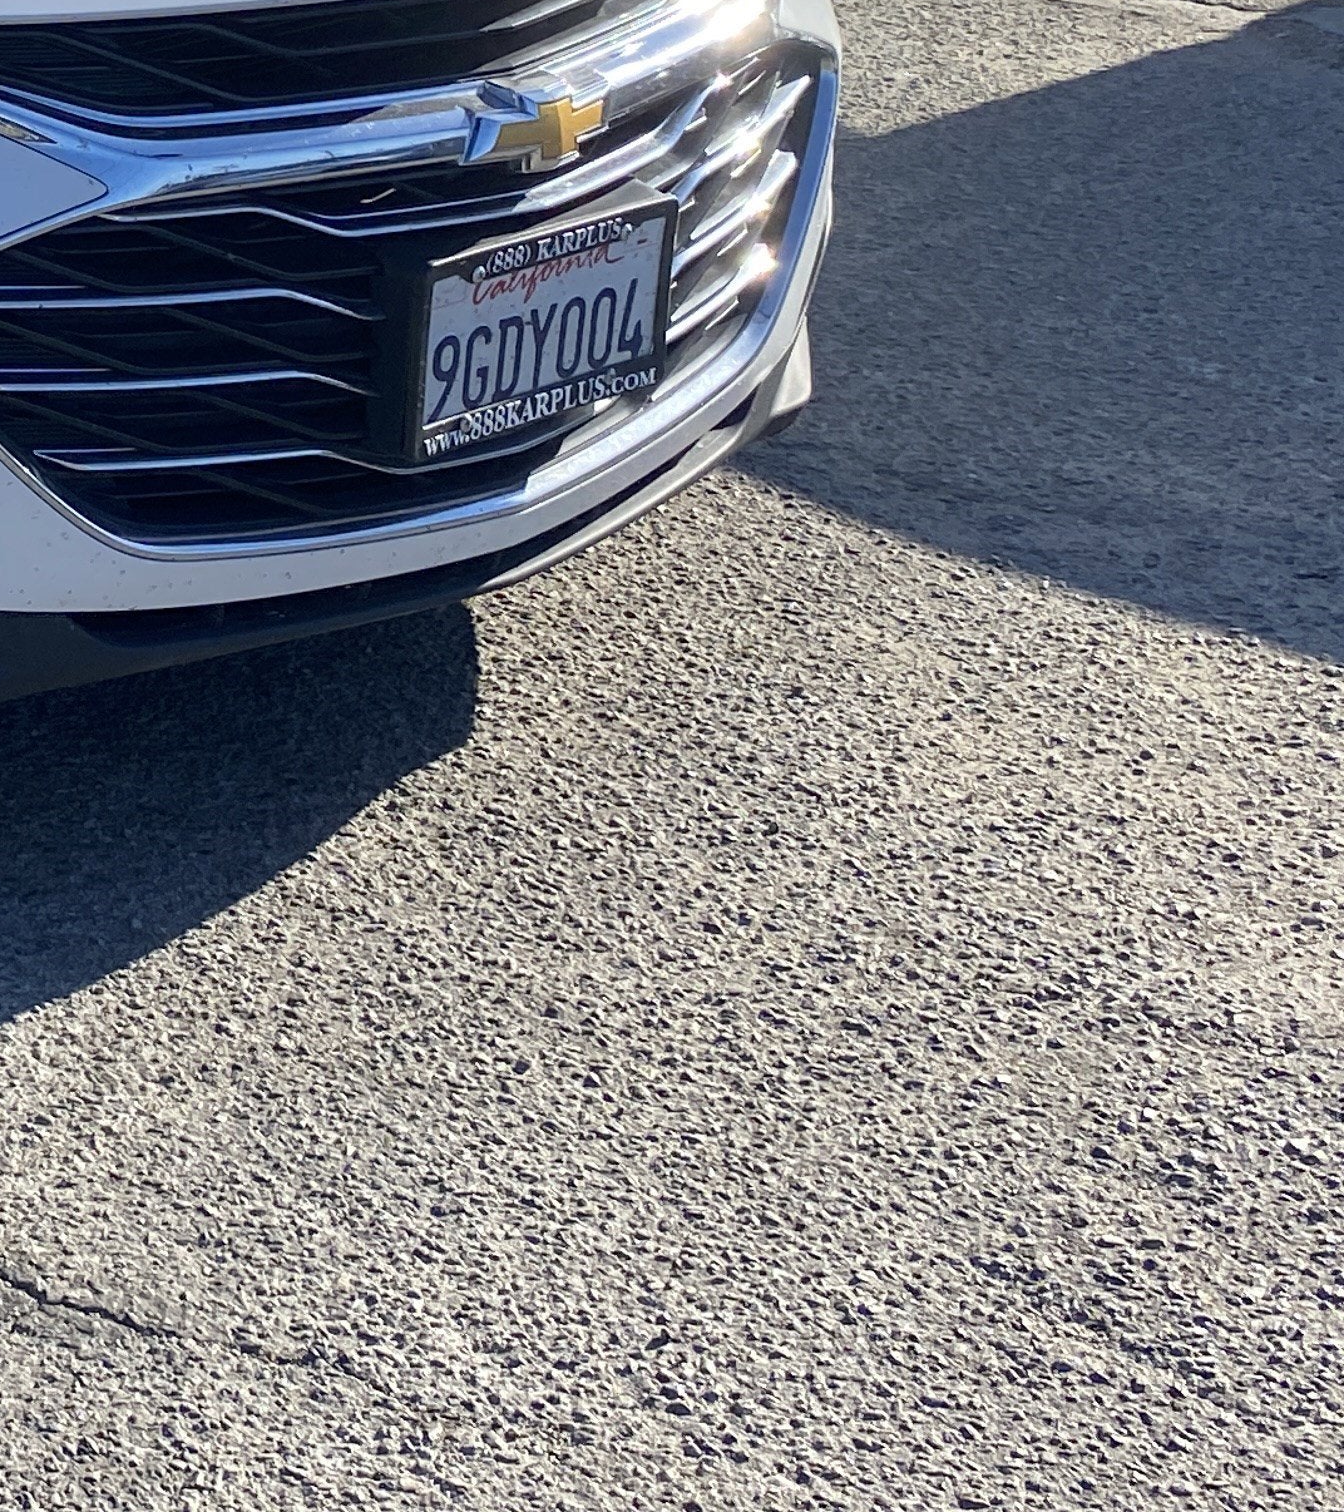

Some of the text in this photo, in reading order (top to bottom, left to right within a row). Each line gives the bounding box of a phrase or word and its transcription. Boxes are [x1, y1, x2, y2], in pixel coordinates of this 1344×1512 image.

[486, 217, 624, 275] (888) KARPLUS
[427, 277, 644, 425] 9GDY004
